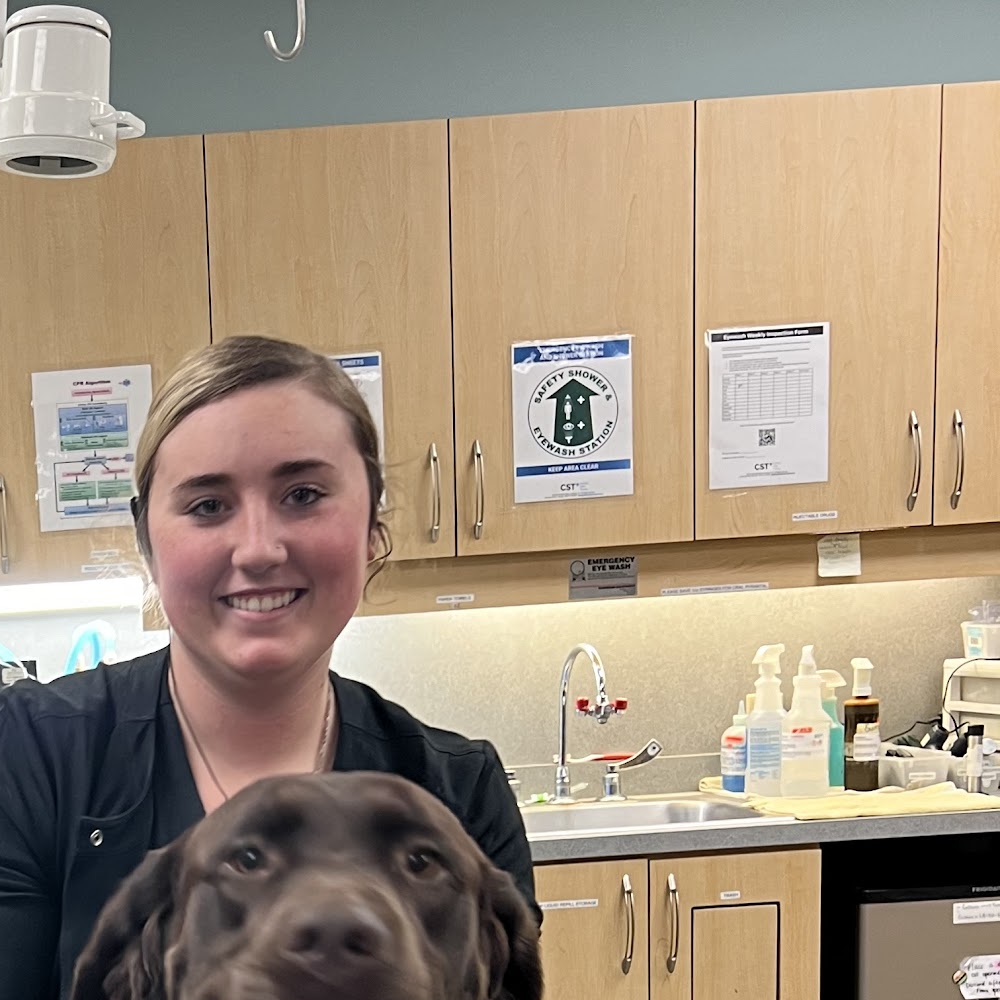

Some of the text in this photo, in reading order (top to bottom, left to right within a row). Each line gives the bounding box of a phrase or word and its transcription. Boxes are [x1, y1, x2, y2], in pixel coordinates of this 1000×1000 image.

[534, 372, 565, 404] SAFETY
[568, 370, 608, 392] SHOWER
[533, 420, 613, 456] EYEWASH STATION
[547, 463, 599, 473] KEEP AREA CLEAR
[587, 556, 635, 565] EMERGENCY
[608, 563, 631, 571] WASH
